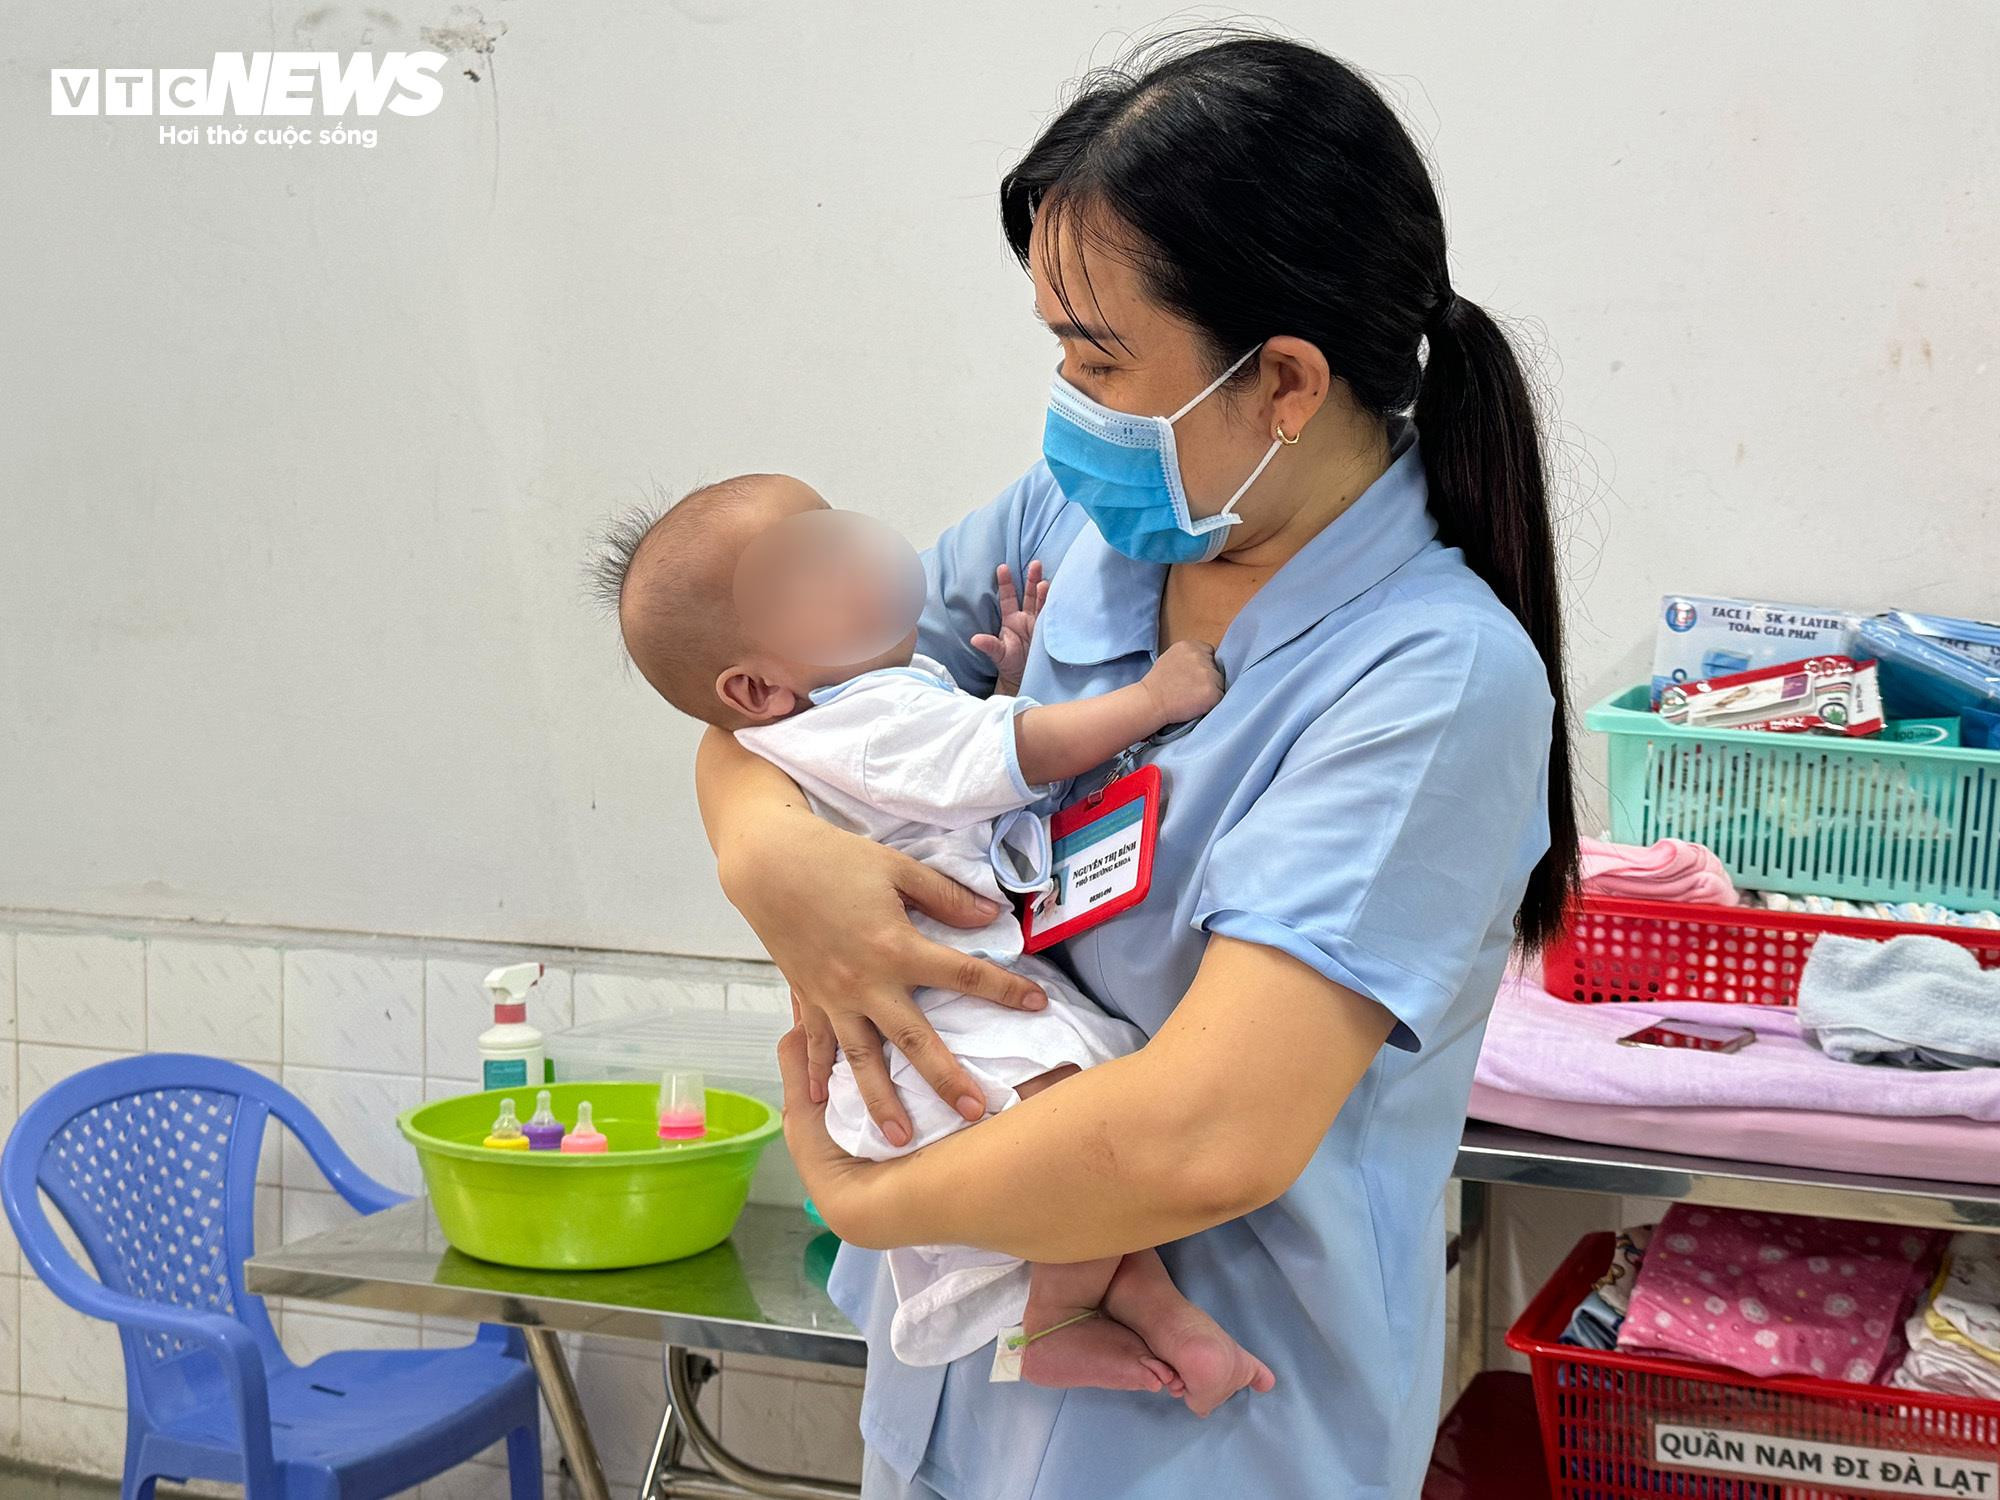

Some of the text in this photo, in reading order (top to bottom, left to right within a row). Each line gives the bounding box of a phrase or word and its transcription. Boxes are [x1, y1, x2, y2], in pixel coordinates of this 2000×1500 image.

[1712, 607, 1741, 619] FACE
[1788, 616, 1796, 625] 4
[1764, 626, 1784, 637] GIA
[1788, 629, 1818, 640] PHAT
[1660, 1431, 1991, 1497] QUẦN NAM ĐI ĐÀ LẠT
